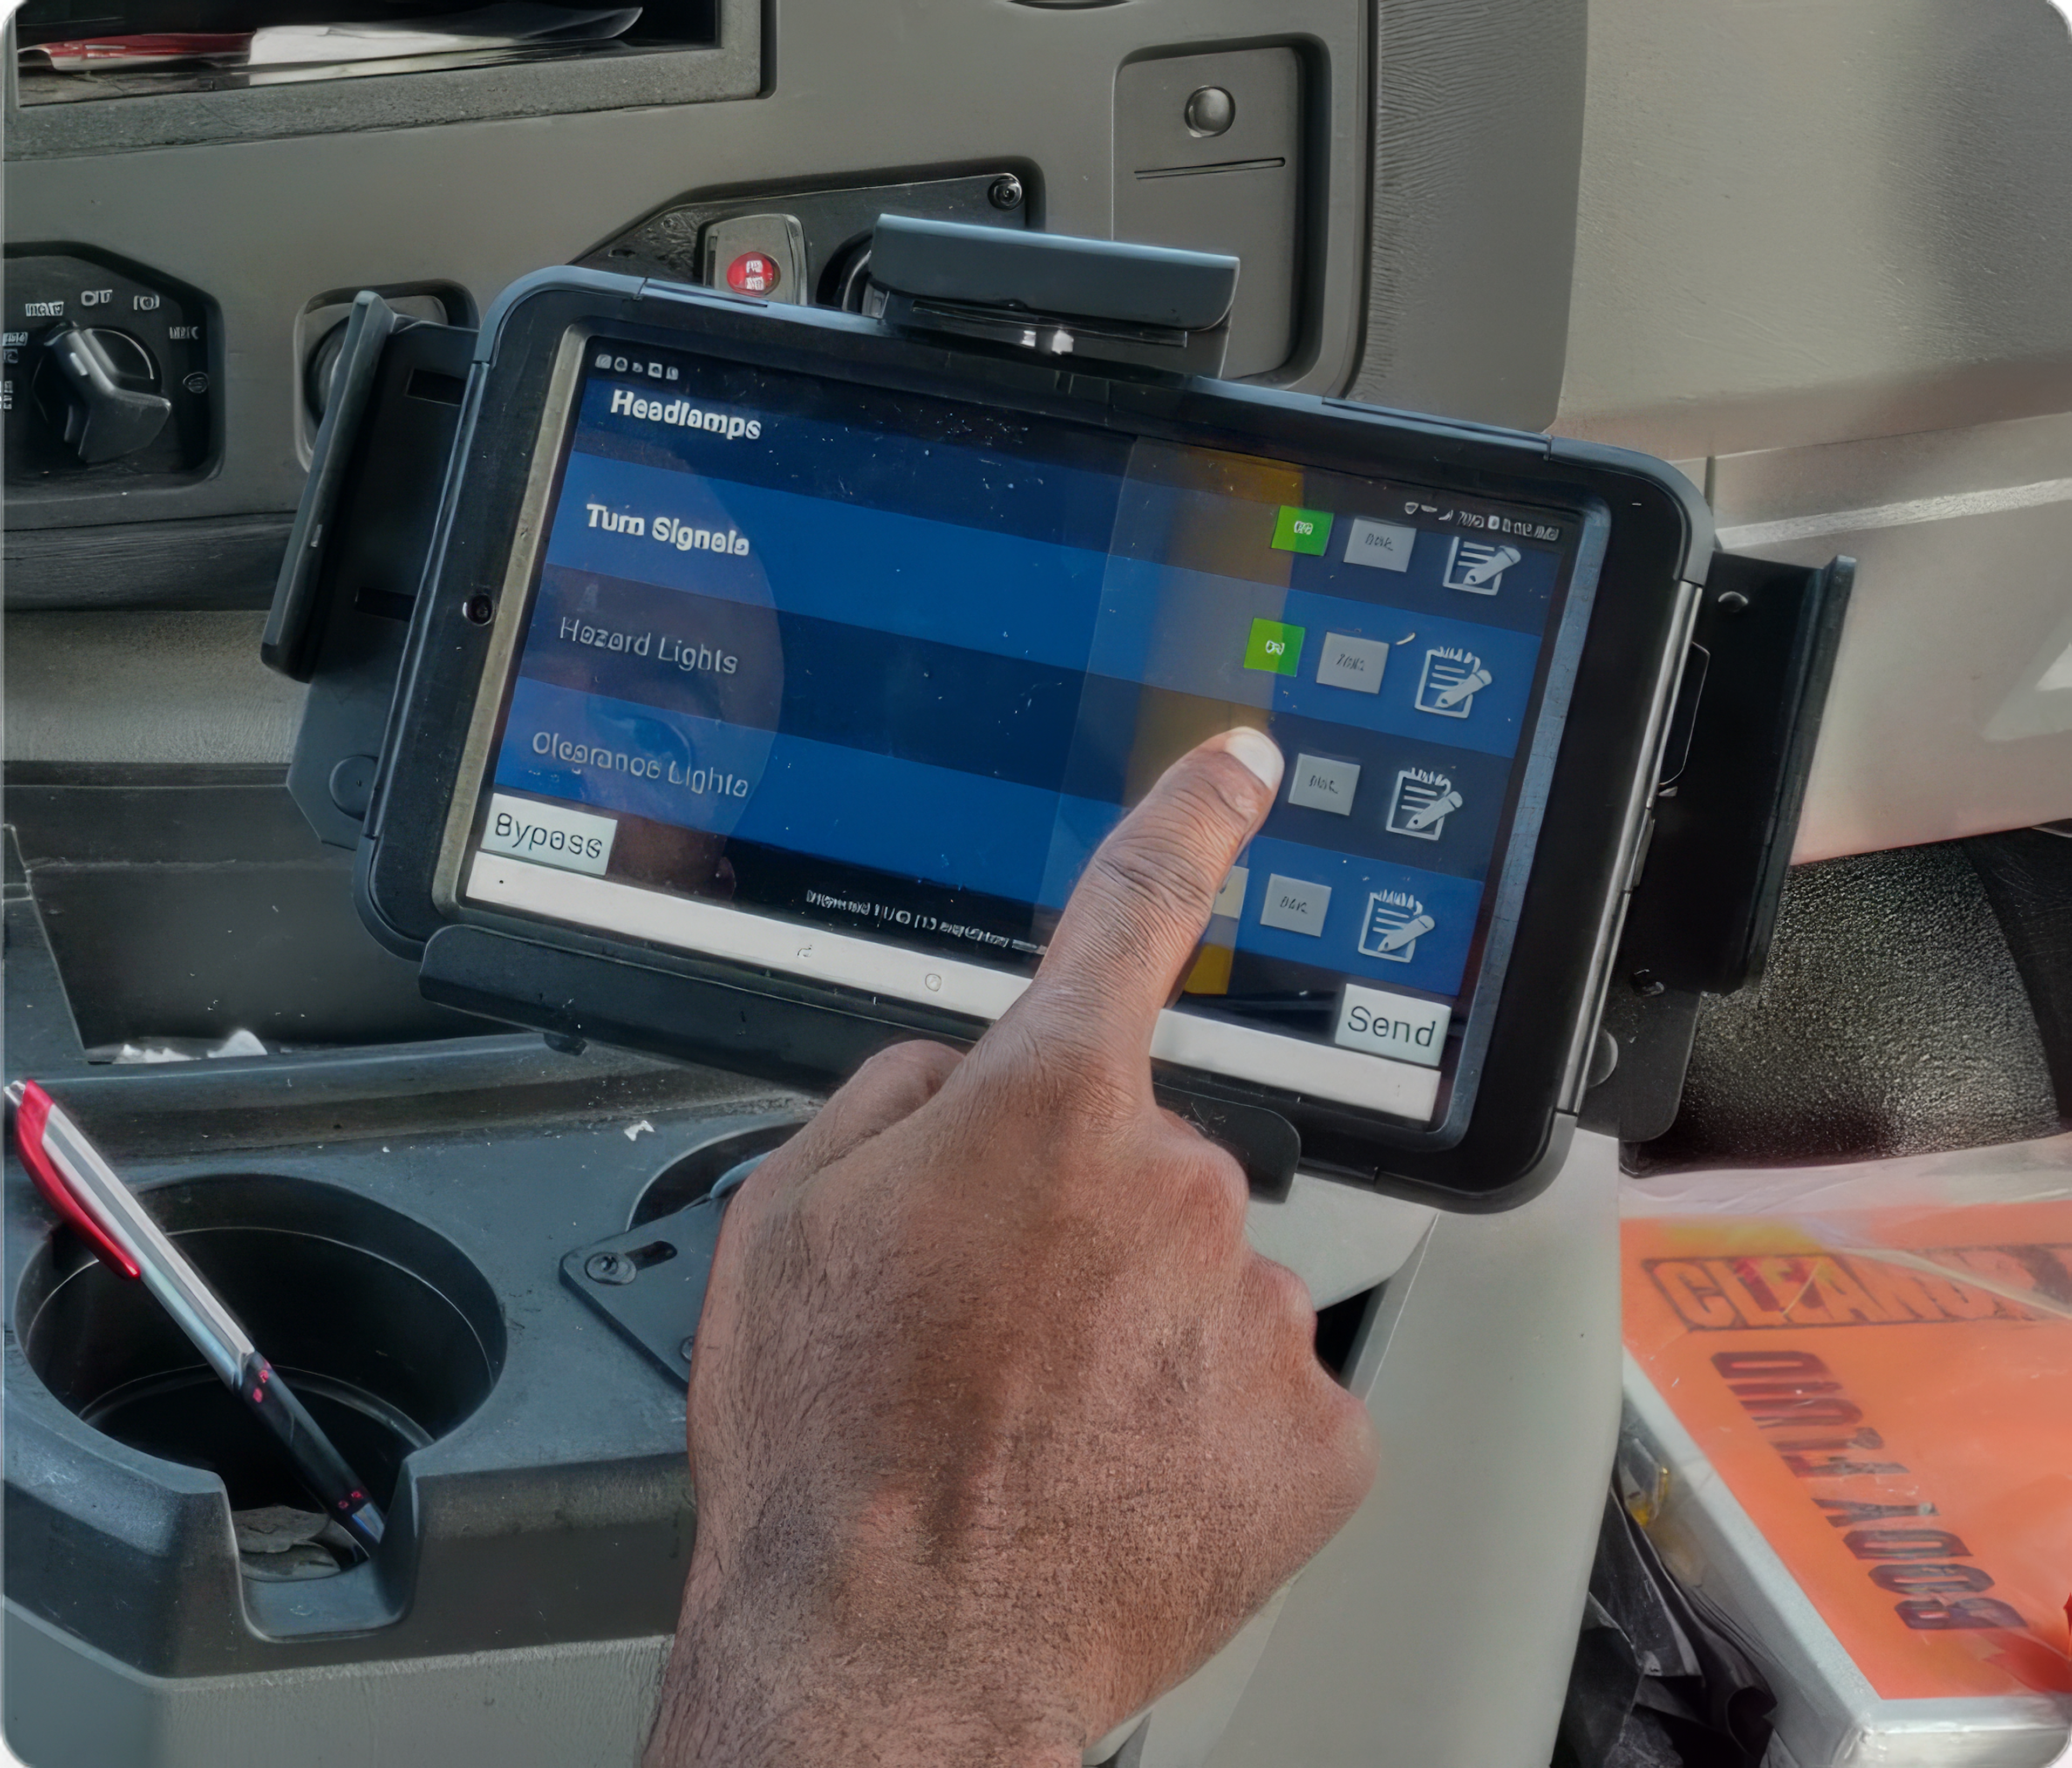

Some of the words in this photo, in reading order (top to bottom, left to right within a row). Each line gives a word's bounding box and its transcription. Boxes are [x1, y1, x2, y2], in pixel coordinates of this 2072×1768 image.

[611, 389, 761, 440] Headlamps
[587, 503, 645, 536] Turn
[652, 516, 749, 556] Signals
[658, 637, 739, 675] Lights
[495, 813, 603, 859] Bypass
[1347, 1005, 1436, 1048] Send
[1710, 1350, 1911, 1478] FLUID
[1811, 1498, 2028, 1629] BODY
